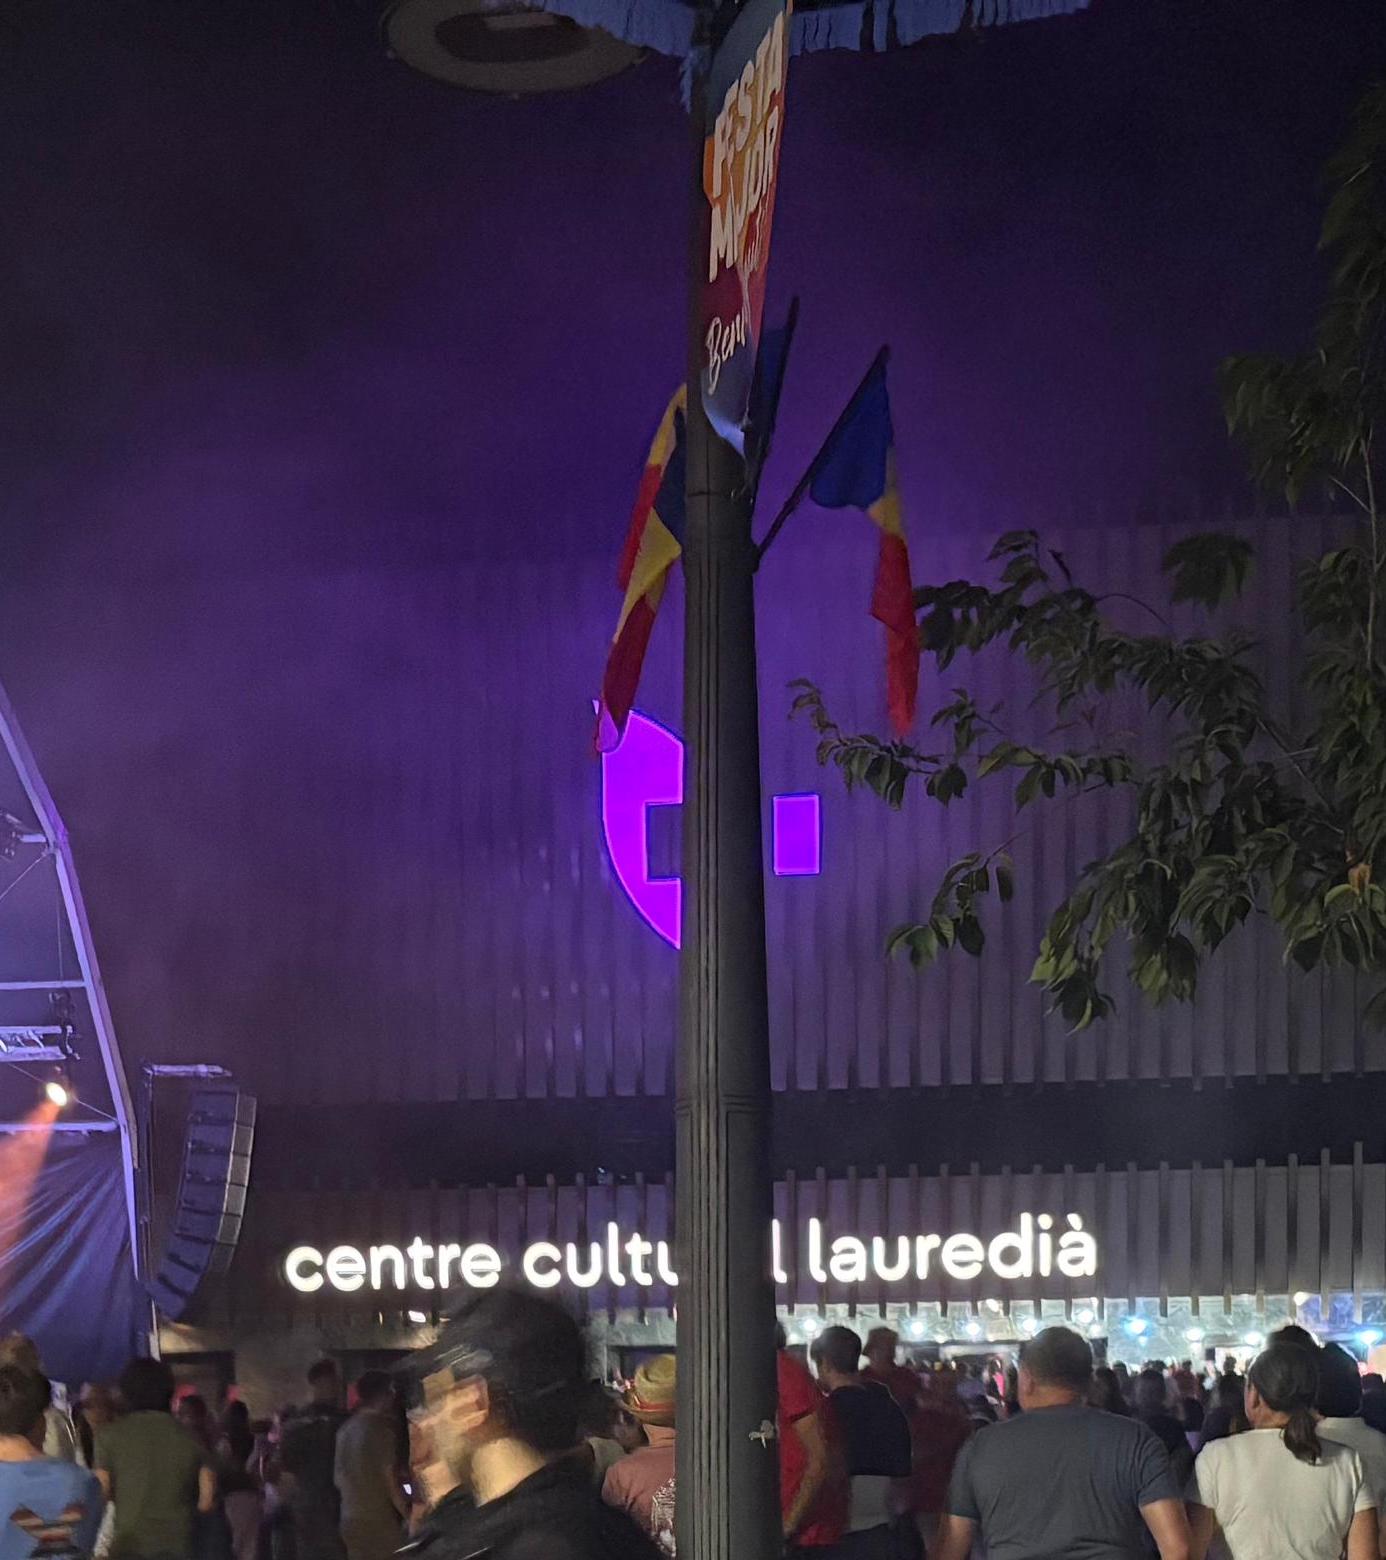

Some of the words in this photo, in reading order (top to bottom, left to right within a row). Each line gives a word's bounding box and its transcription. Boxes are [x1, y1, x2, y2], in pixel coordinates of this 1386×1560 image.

[714, 11, 785, 198] FESTA
[285, 1236, 502, 1293] centre
[808, 1211, 1098, 1284] lauredià
